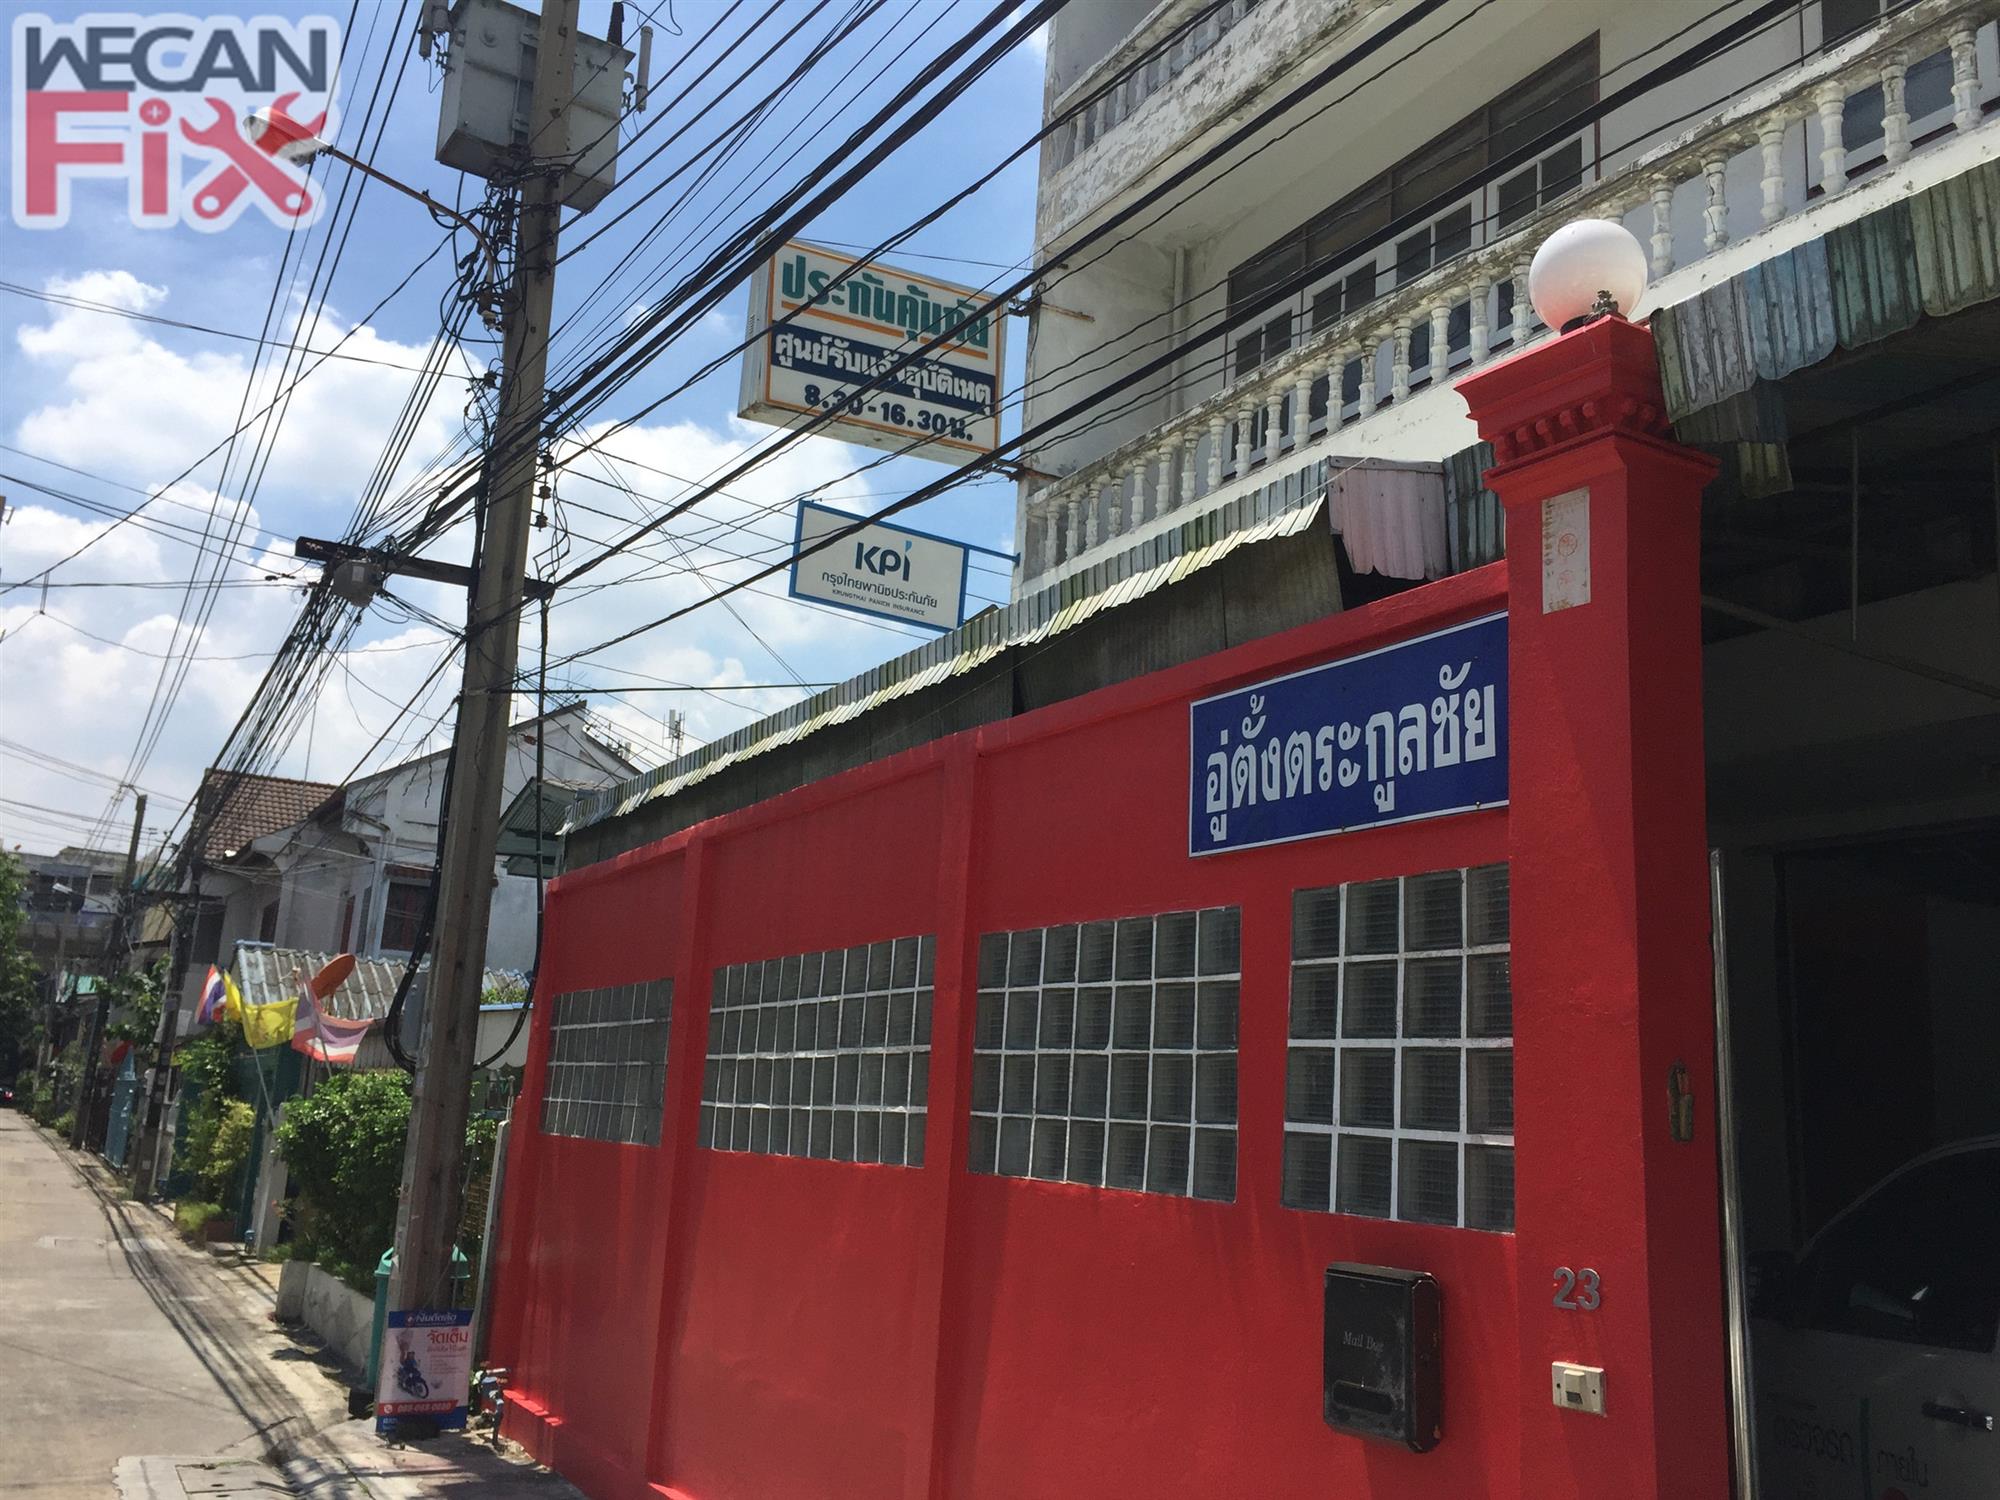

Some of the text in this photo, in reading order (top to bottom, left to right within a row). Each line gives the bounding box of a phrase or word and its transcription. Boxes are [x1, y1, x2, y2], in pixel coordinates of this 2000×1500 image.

[782, 255, 989, 348] ประกันคุ้มภัย
[822, 571, 938, 609] กรุงไทยพานิชประกันภัย
[892, 603, 926, 616] INSURANCE
[1206, 661, 1496, 842] อู่ตั้งตระกูลชัย
[1552, 1266, 1601, 1311] 23
[1343, 1330, 1364, 1347] Mail
